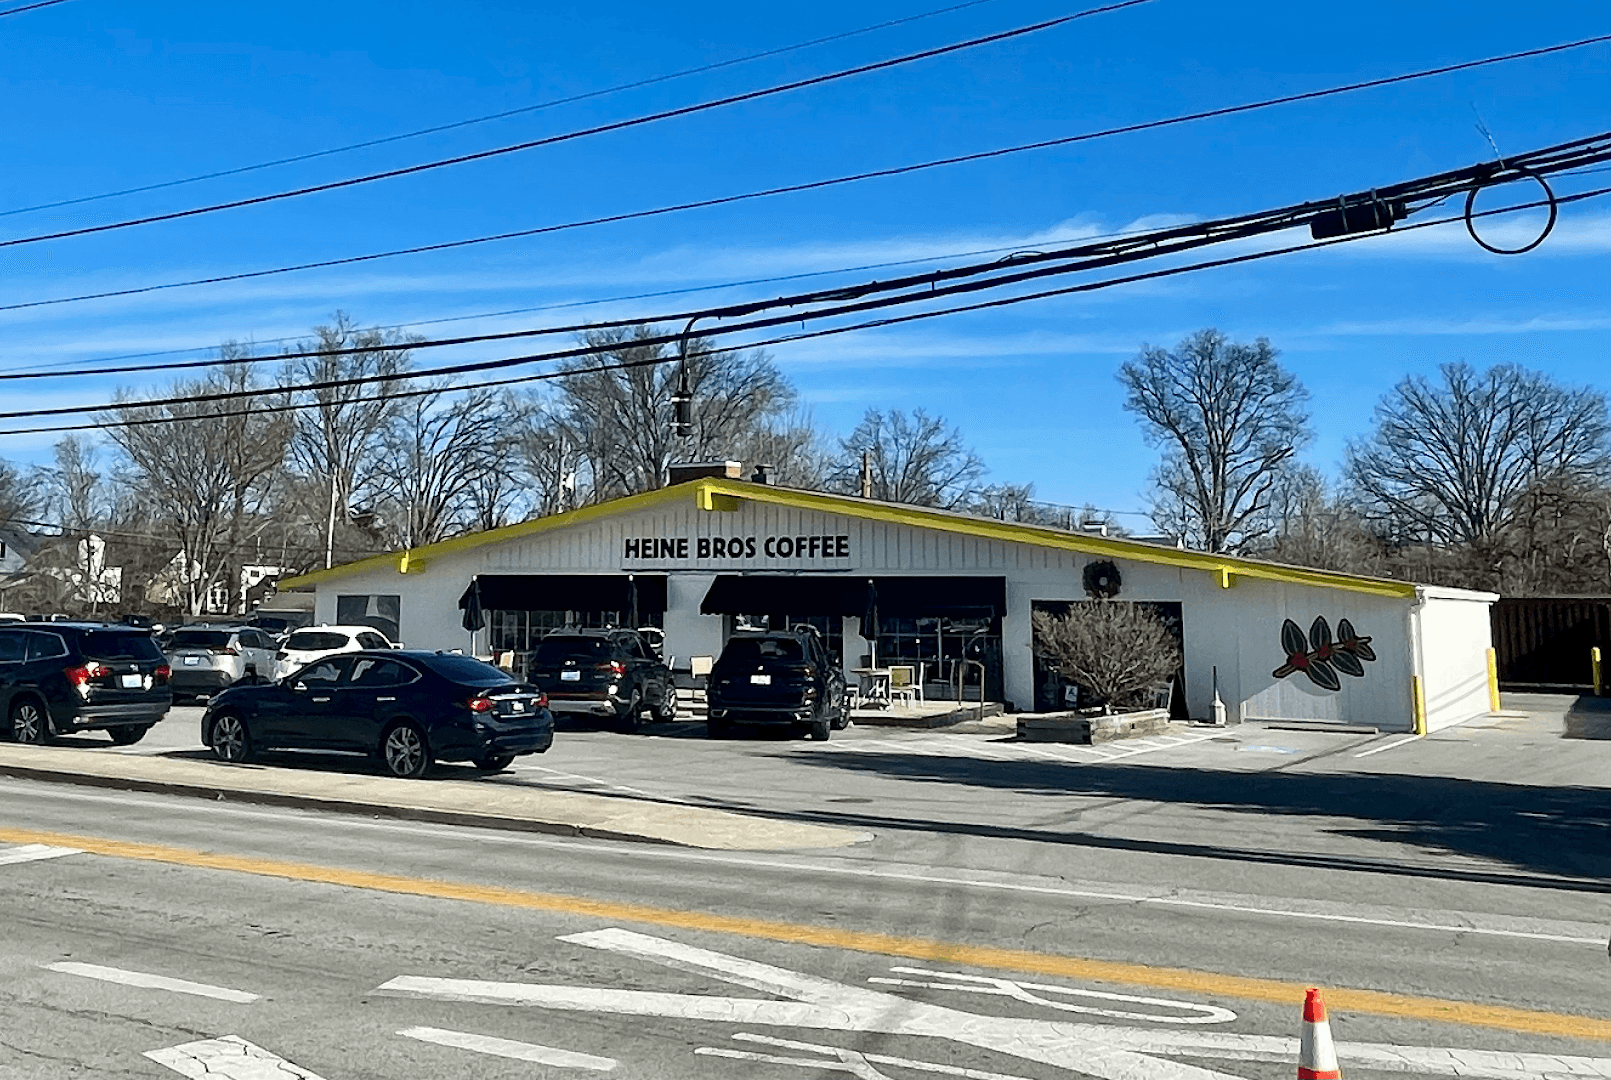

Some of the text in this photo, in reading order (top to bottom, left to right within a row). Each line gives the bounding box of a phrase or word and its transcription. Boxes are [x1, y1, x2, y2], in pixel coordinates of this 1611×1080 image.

[625, 536, 849, 559] HEINE BROS COFFEE
